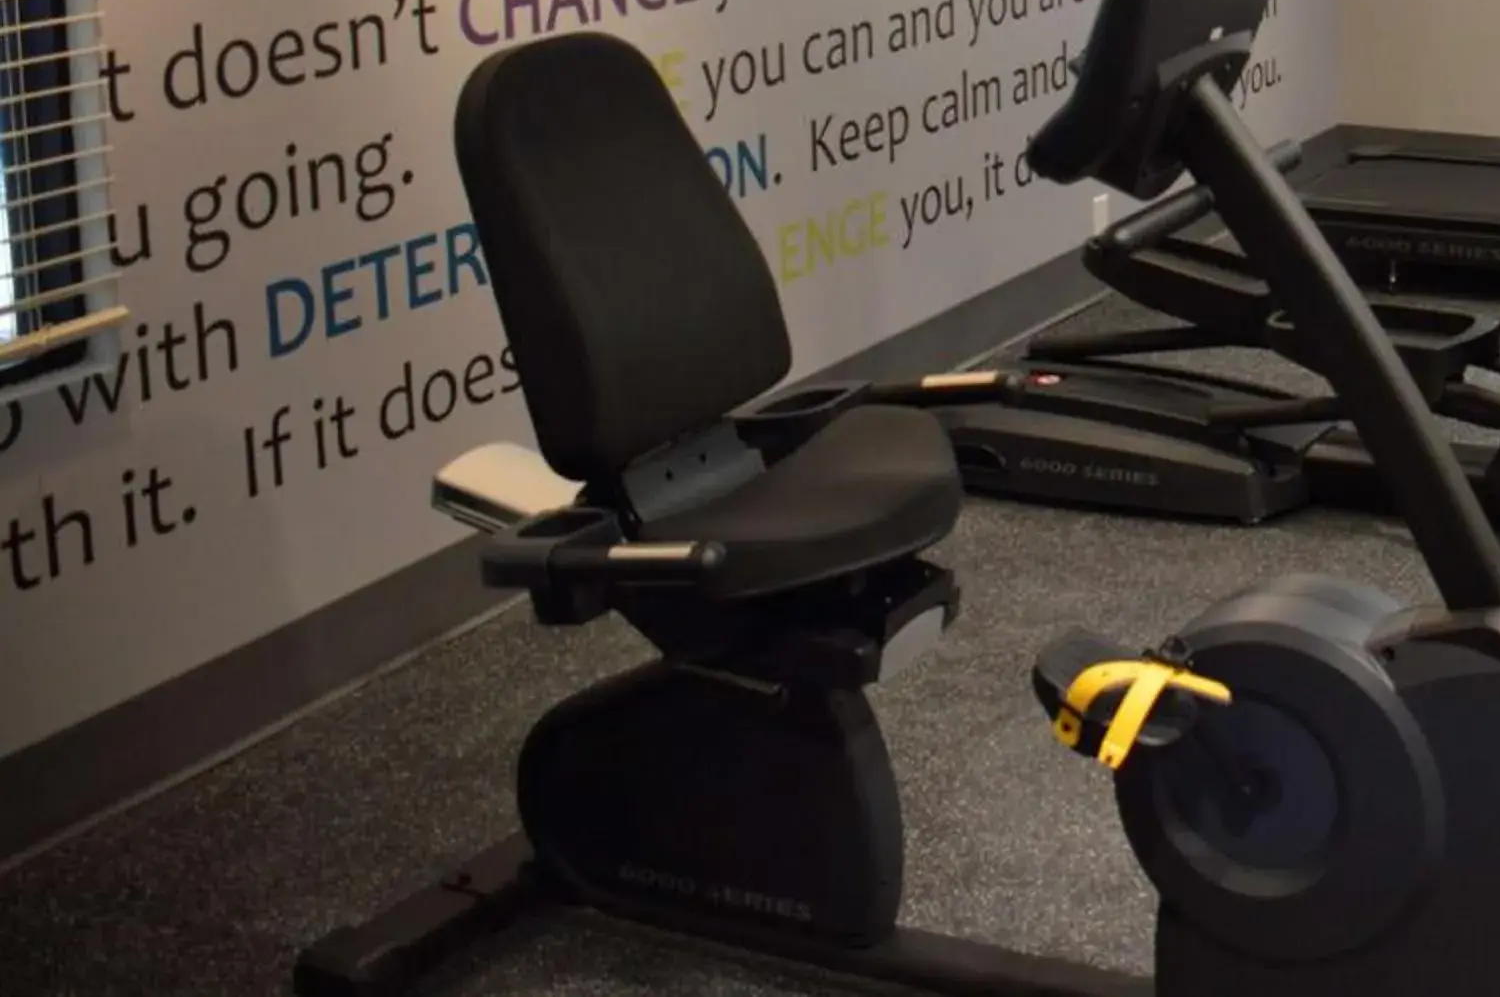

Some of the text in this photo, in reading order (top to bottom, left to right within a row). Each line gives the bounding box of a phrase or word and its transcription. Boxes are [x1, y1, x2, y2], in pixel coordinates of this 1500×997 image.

[57, 301, 238, 424] with
[810, 105, 909, 171] Keep
[922, 69, 1001, 134] calm
[1013, 40, 1068, 105] and
[1240, 59, 1281, 109] you.
[184, 132, 415, 273] going.
[701, 43, 785, 122] you
[803, 21, 873, 74] can
[122, 468, 196, 547] it.
[244, 406, 292, 498] If
[313, 396, 358, 469] it
[900, 176, 973, 250] you,
[984, 152, 1005, 201] it
